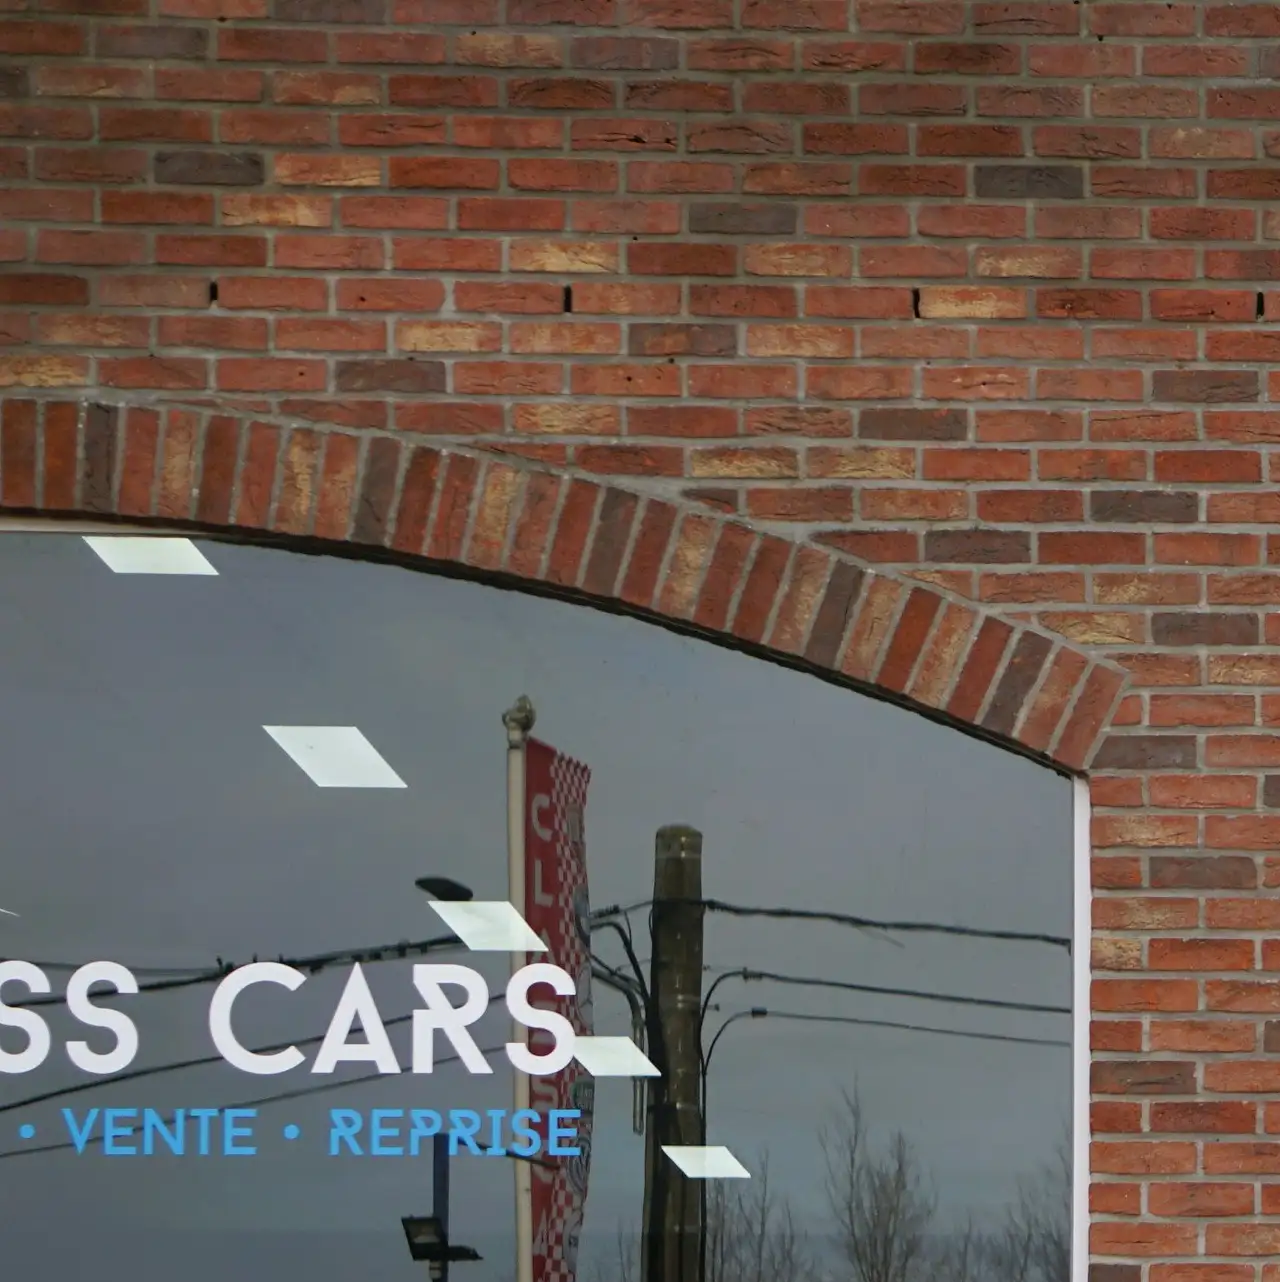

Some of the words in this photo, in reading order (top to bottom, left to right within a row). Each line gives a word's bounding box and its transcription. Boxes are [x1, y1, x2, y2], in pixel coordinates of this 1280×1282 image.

[208, 960, 577, 1076] CARS
[61, 1107, 258, 1156] VENTE
[328, 1107, 581, 1157] REPRISE
